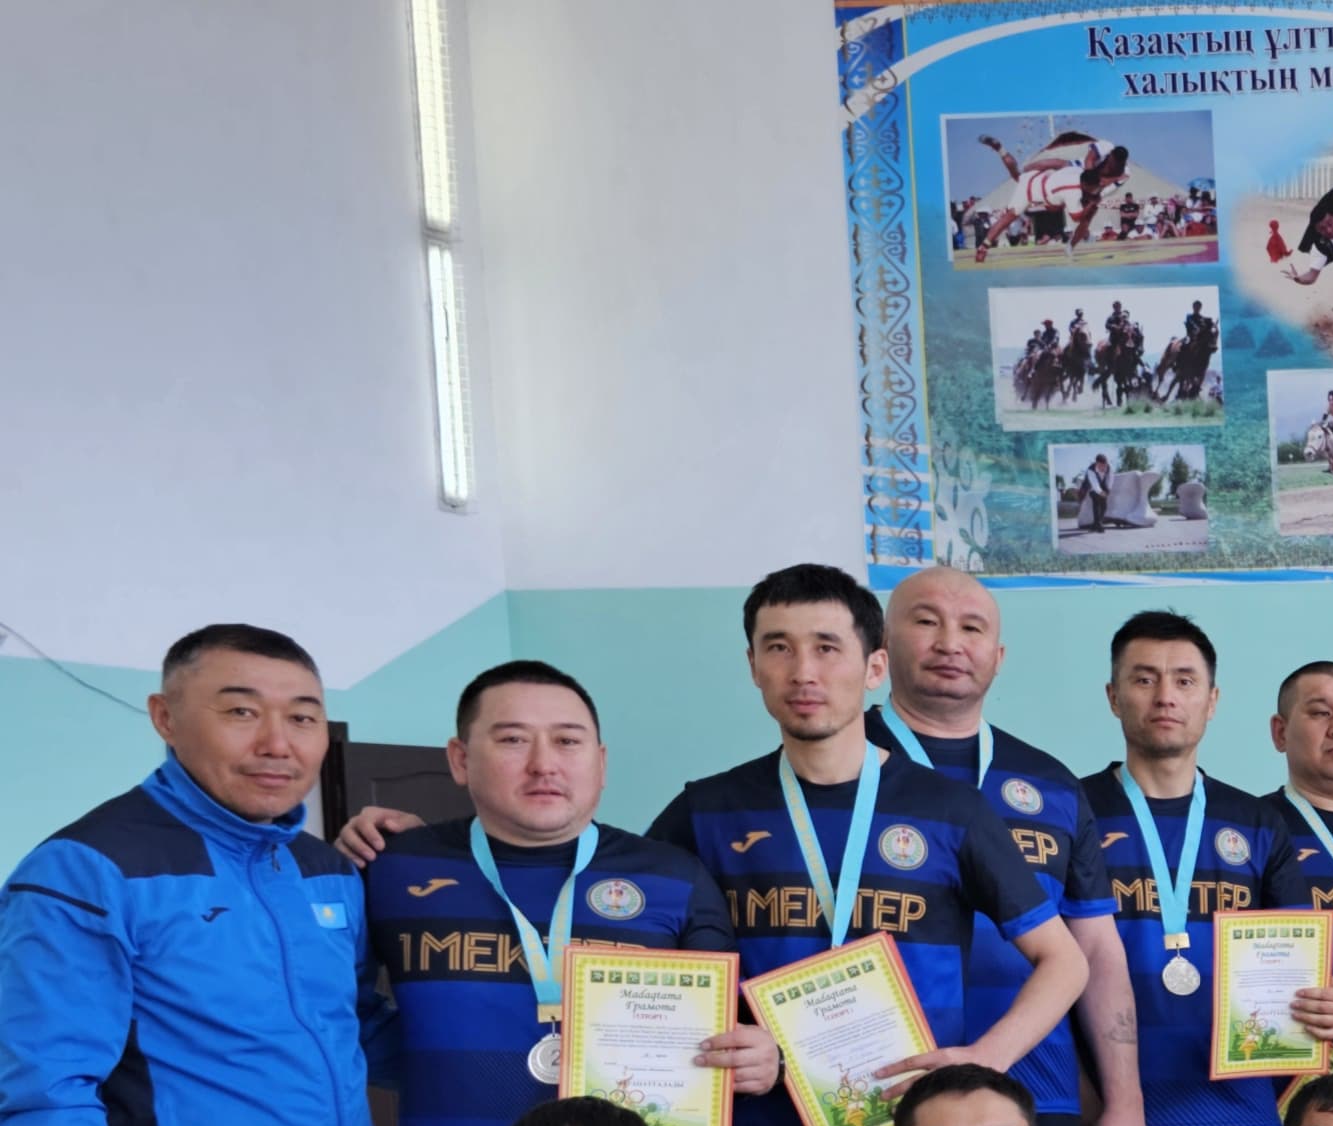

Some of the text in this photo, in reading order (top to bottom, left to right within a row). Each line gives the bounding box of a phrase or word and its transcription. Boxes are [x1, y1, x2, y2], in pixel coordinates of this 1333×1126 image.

[1087, 27, 1254, 63] Қазақтың
[1124, 68, 1298, 96] халықтың
[1111, 878, 1251, 914] METEP
[399, 933, 412, 972] 1
[551, 1049, 561, 1066] 2
